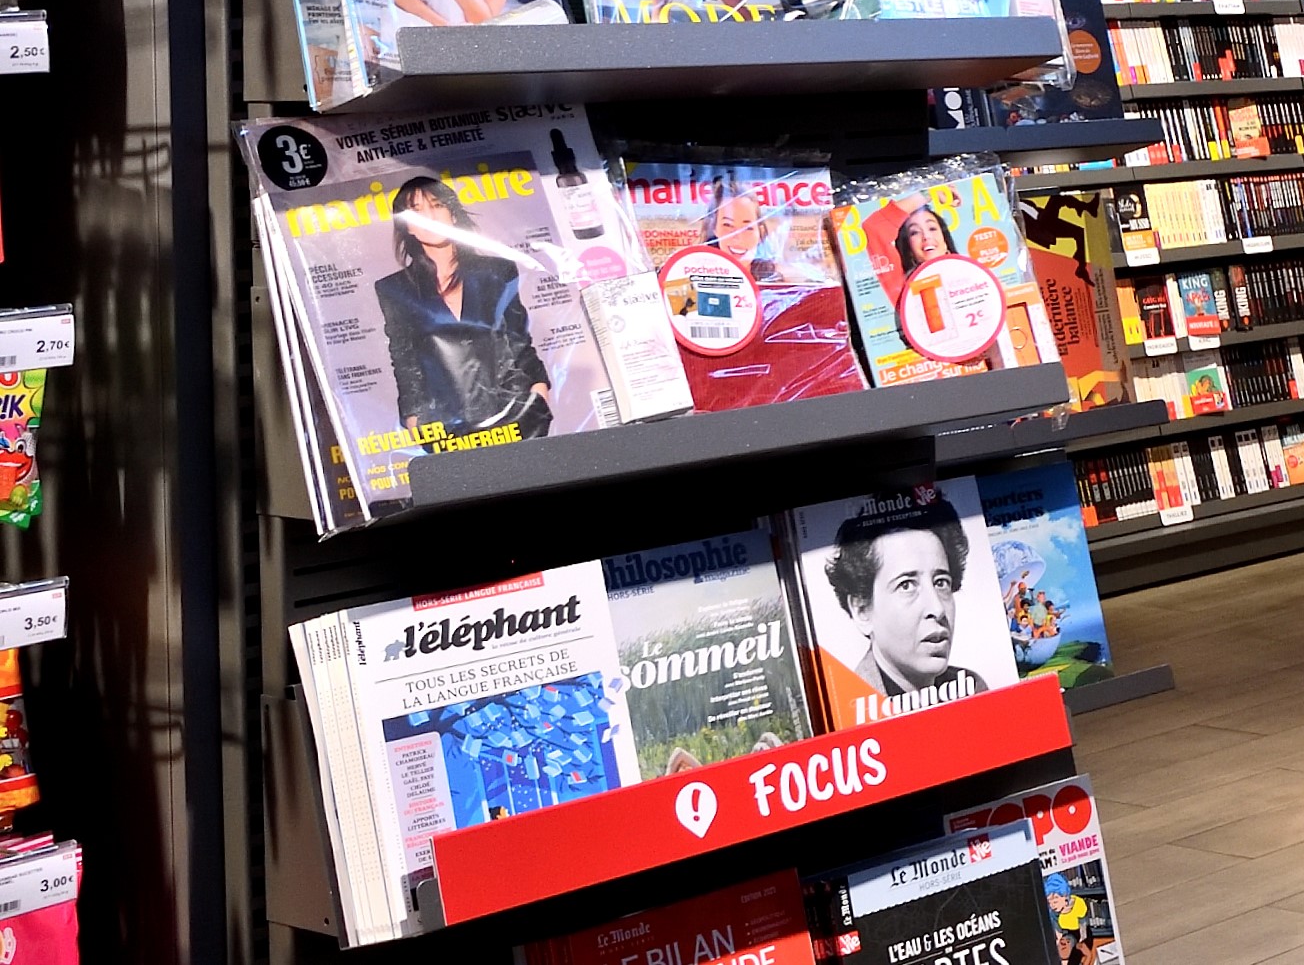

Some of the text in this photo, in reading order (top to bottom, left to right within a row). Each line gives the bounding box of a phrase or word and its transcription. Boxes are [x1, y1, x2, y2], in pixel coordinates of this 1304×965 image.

[10, 45, 46, 61] 2,50€
[335, 111, 493, 151] VOTRE SÉRUM BOTANIQUE
[357, 127, 485, 164] ANTI-ÂGE & FERMETÉ
[684, 266, 730, 276] pochette
[948, 280, 990, 300] bracelet
[1062, 285, 1084, 349] balance
[36, 339, 70, 355] 2,70€
[357, 421, 447, 457] RÉVEILLER
[433, 423, 523, 454] L'ÉNERGIE
[24, 614, 58, 631] 3,50€
[403, 594, 582, 659] l'éléphant
[641, 639, 664, 659] Le
[402, 660, 578, 709] LA LANGUE FRANÇAISE
[406, 648, 570, 694] TOUS LES SECRETS DE
[854, 671, 976, 726] Hannah
[748, 738, 888, 817] FOCUS
[1059, 835, 1099, 857] VIANDE
[40, 874, 74, 893] 3,00€
[891, 847, 967, 889] Le Monde
